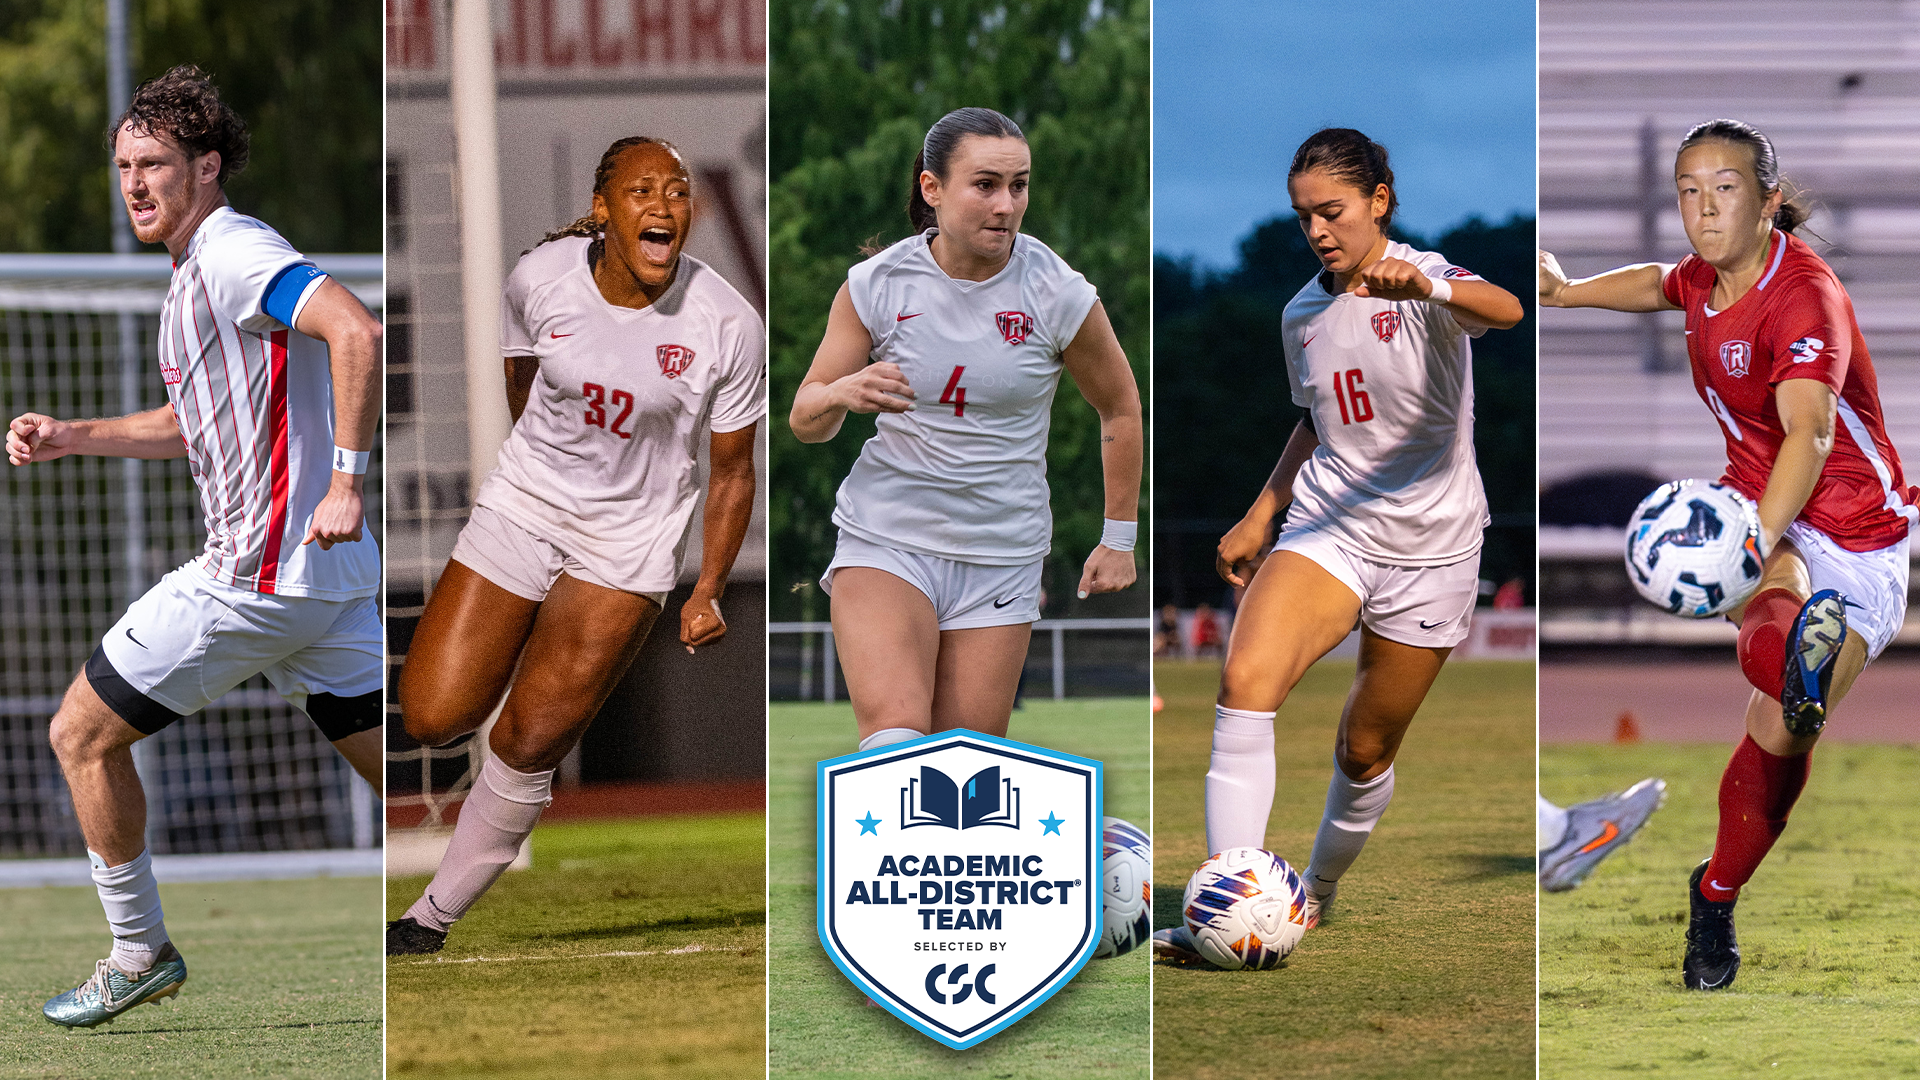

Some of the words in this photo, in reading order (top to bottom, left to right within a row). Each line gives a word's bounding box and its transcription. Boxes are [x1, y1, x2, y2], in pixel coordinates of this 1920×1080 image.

[582, 382, 634, 440] 32
[939, 365, 969, 417] 4
[1333, 368, 1374, 426] 16
